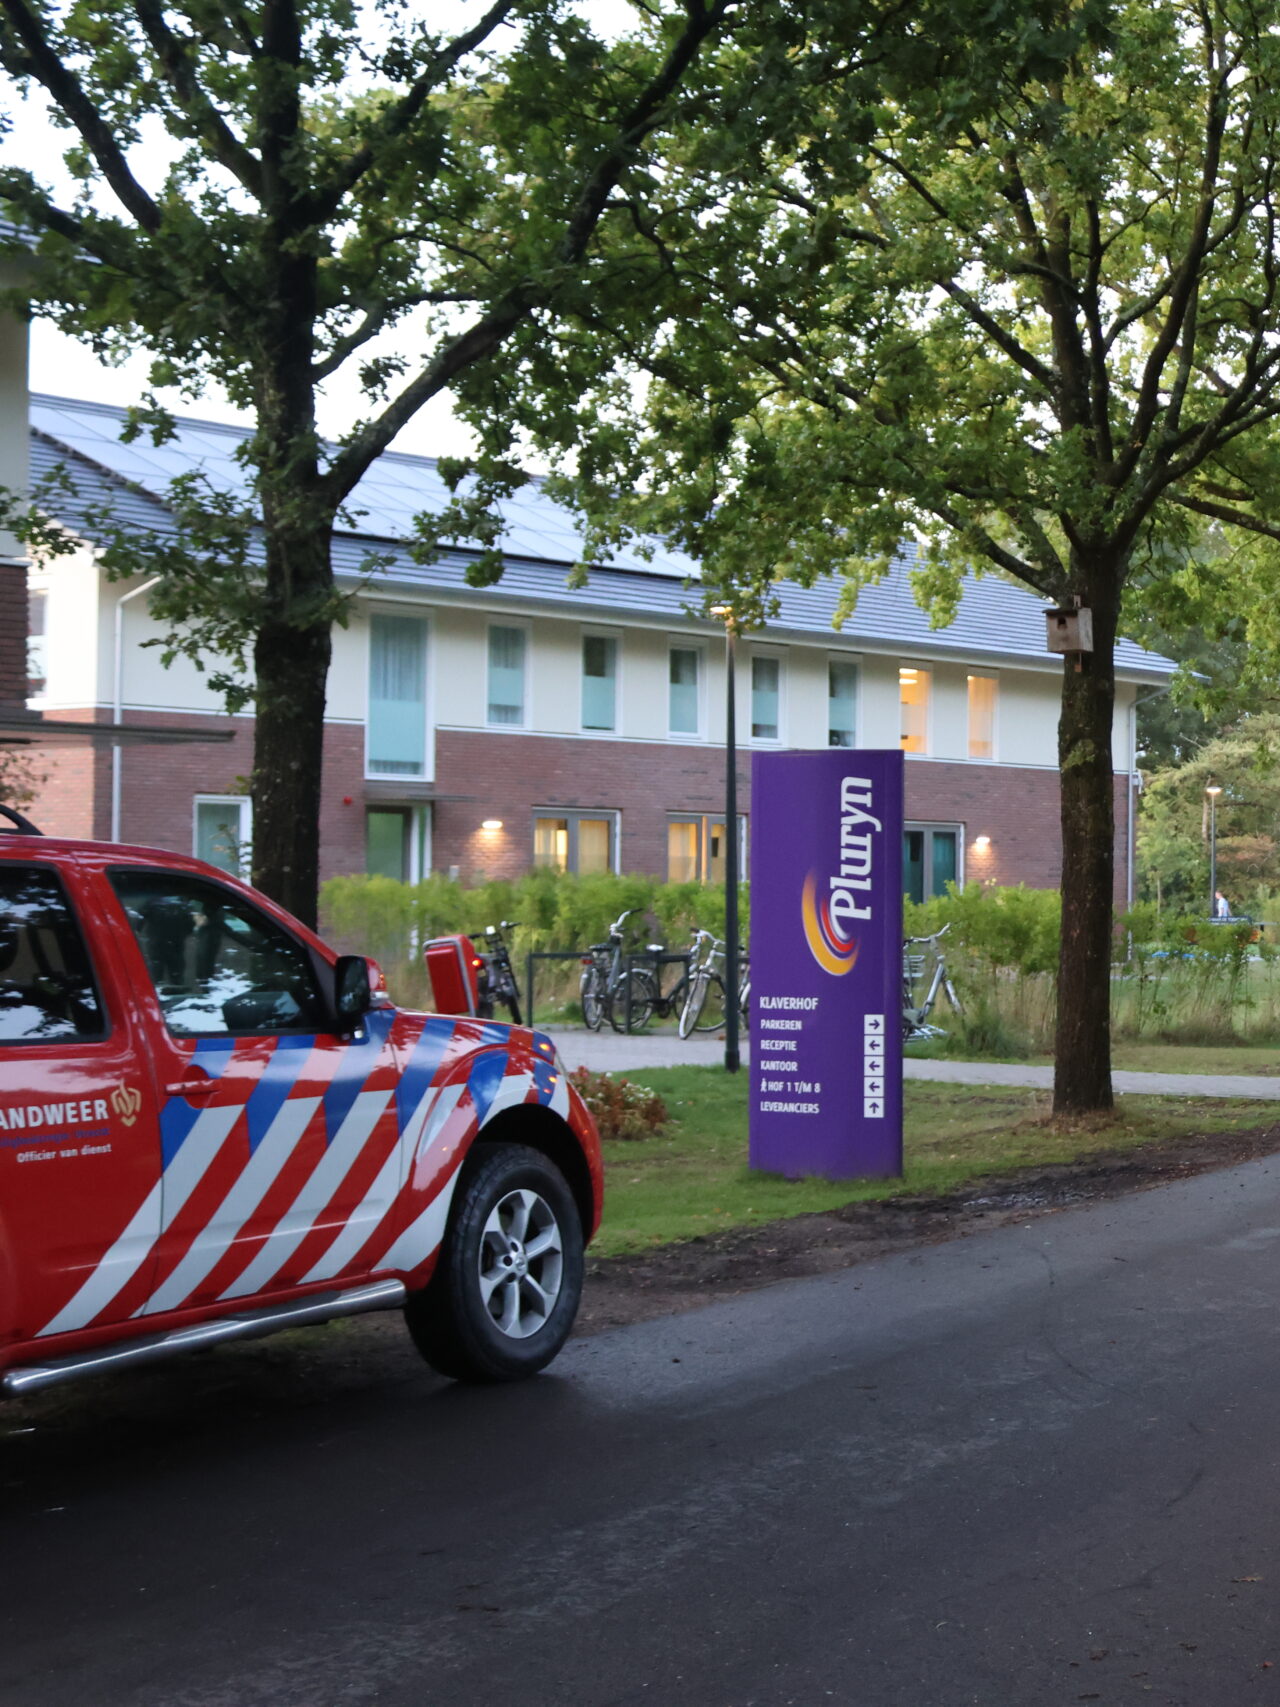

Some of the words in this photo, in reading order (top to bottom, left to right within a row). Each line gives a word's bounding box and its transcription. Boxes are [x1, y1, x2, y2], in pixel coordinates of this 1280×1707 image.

[830, 776, 882, 941] Pluryn
[760, 997, 818, 1010] KLAVERHOF
[760, 1019, 802, 1030] PARKEREN
[760, 1040, 797, 1051] RECEPTIE
[760, 1060, 798, 1071] KANTOOR
[768, 1081, 784, 1092] HOF
[787, 1082, 792, 1092] 1
[794, 1082, 812, 1094] T/M
[814, 1083, 821, 1093] 8
[760, 1101, 820, 1114] LEVERANCIERS
[60, 1148, 78, 1158] van
[81, 1143, 112, 1155] dienst
